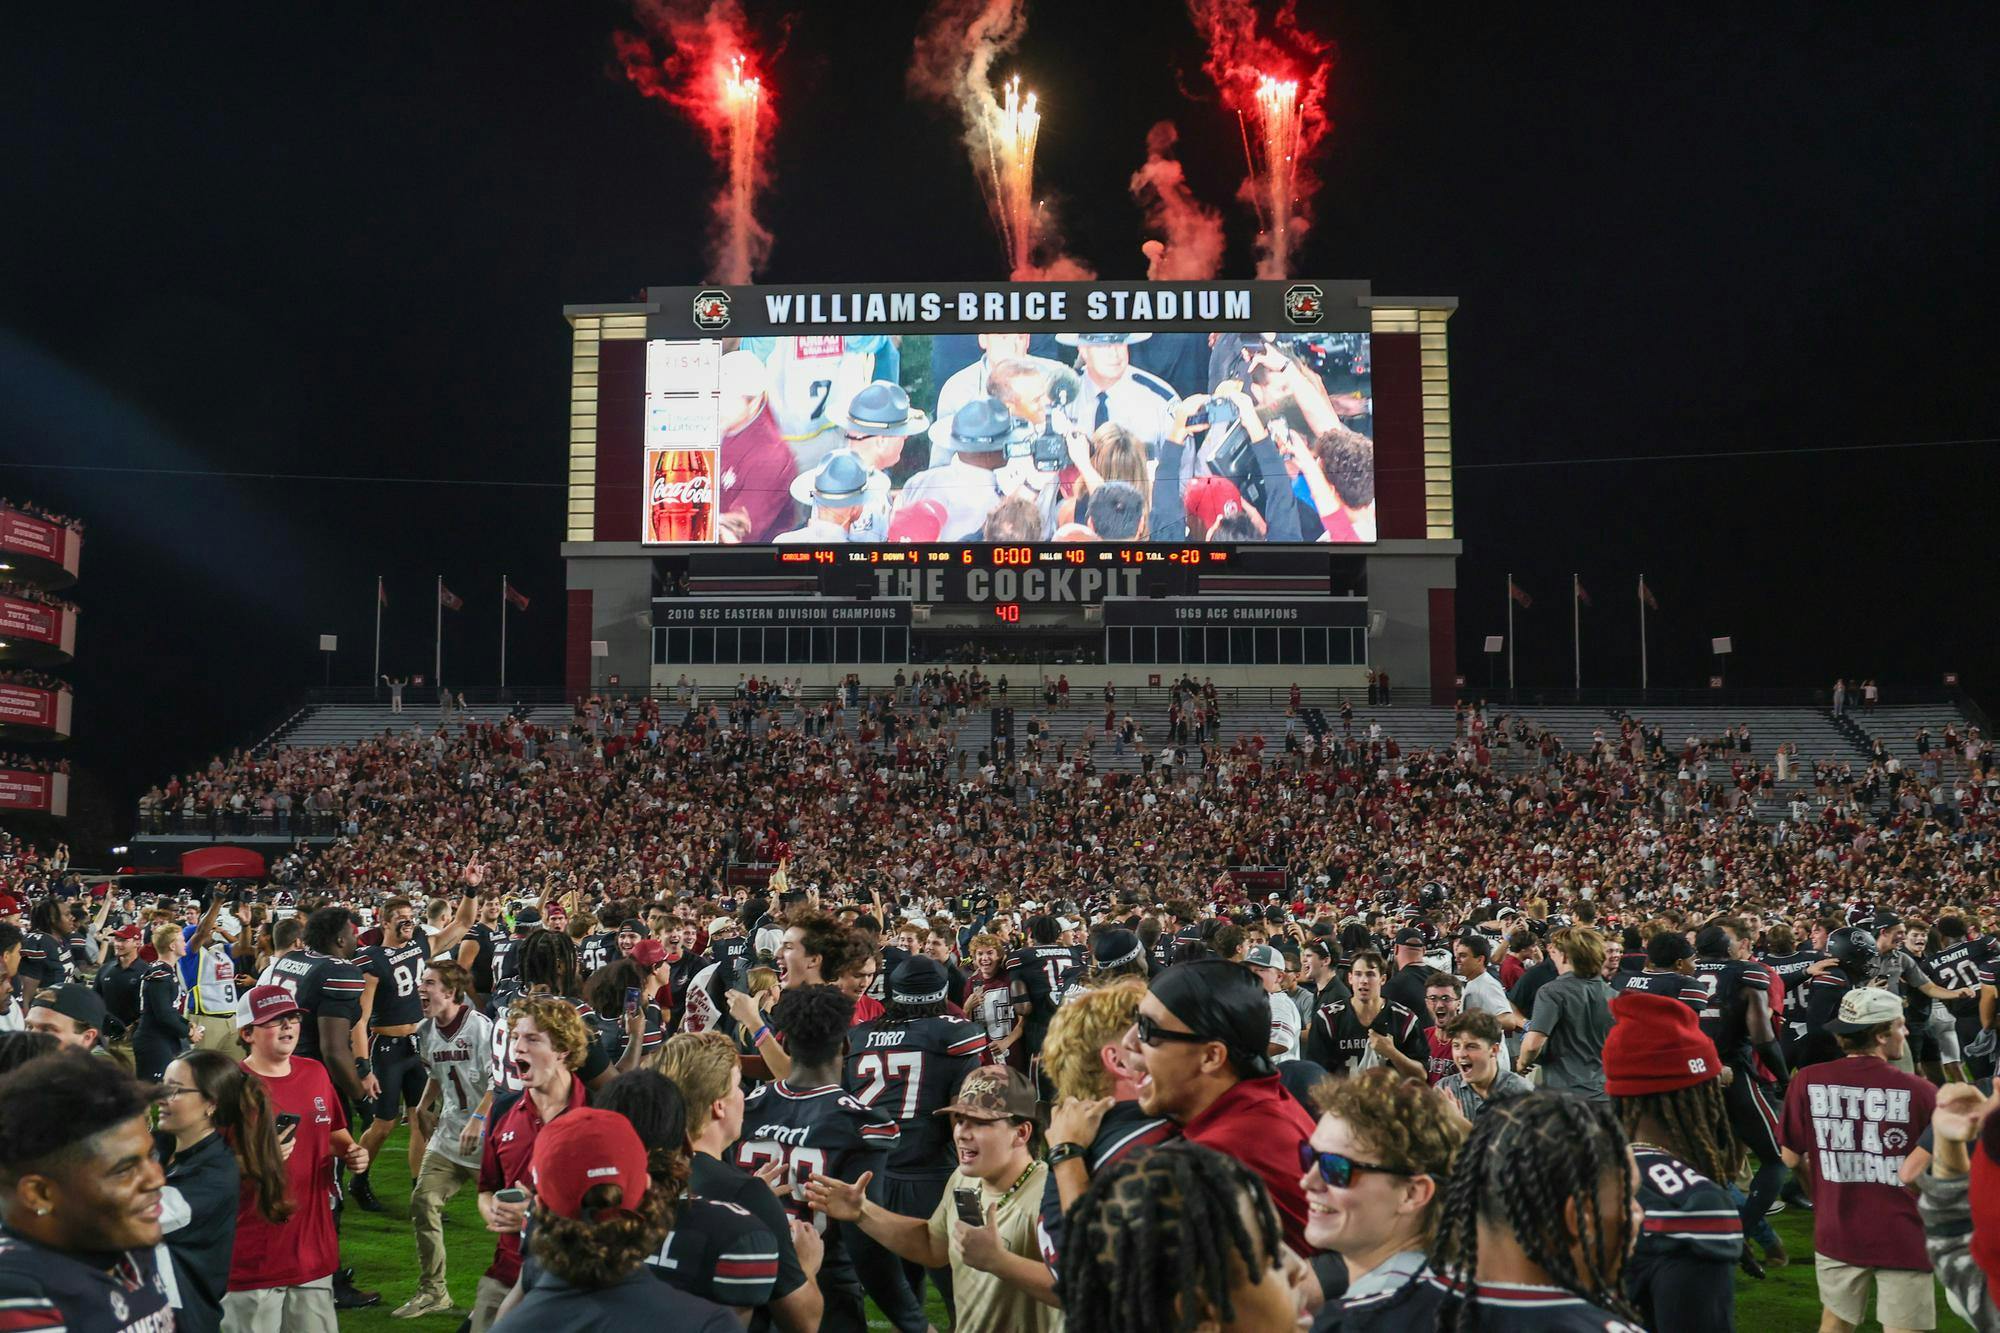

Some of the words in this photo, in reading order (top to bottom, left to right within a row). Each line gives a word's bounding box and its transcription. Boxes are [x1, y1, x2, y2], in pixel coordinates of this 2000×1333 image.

[764, 291, 1067, 324] WILLIAMS-BRICE
[1086, 289, 1251, 321] STADIUM
[815, 550, 834, 563] 44
[871, 551, 878, 562] 3
[883, 553, 905, 561] DOWN
[908, 551, 918, 563] 4
[962, 550, 972, 563] 6
[993, 547, 1032, 564] 0:00
[1066, 550, 1084, 563] 40
[1121, 550, 1130, 562] 4
[1181, 549, 1199, 563] 20
[873, 568, 944, 602] THE
[966, 567, 1142, 602] COCKPIT
[7, 610, 31, 621] TOTAL
[667, 608, 694, 620] 2010
[700, 608, 720, 620] SEC
[725, 608, 773, 619] EASTERN
[777, 608, 827, 619] DIVISION
[832, 608, 897, 619] CHAMPIONS
[995, 604, 1020, 622] 40
[1175, 608, 1202, 619] 1969
[1207, 608, 1228, 619] ACC
[1233, 608, 1298, 619] CHAMPIONS
[388, 946, 422, 965] GAMECOCKS
[1035, 948, 1072, 958] JOHNSON
[393, 957, 426, 997] 84
[1626, 976, 1650, 989] RICE
[223, 984, 233, 1003] 9
[866, 1031, 906, 1049] FORD
[1688, 1057, 1707, 1074] 82
[448, 1065, 468, 1110] 1
[856, 1051, 922, 1119] 27
[1807, 1084, 1911, 1123] BITCH
[754, 1124, 810, 1147] SCOTT
[1812, 1117, 1856, 1151] I'M
[1862, 1121, 1883, 1154] A
